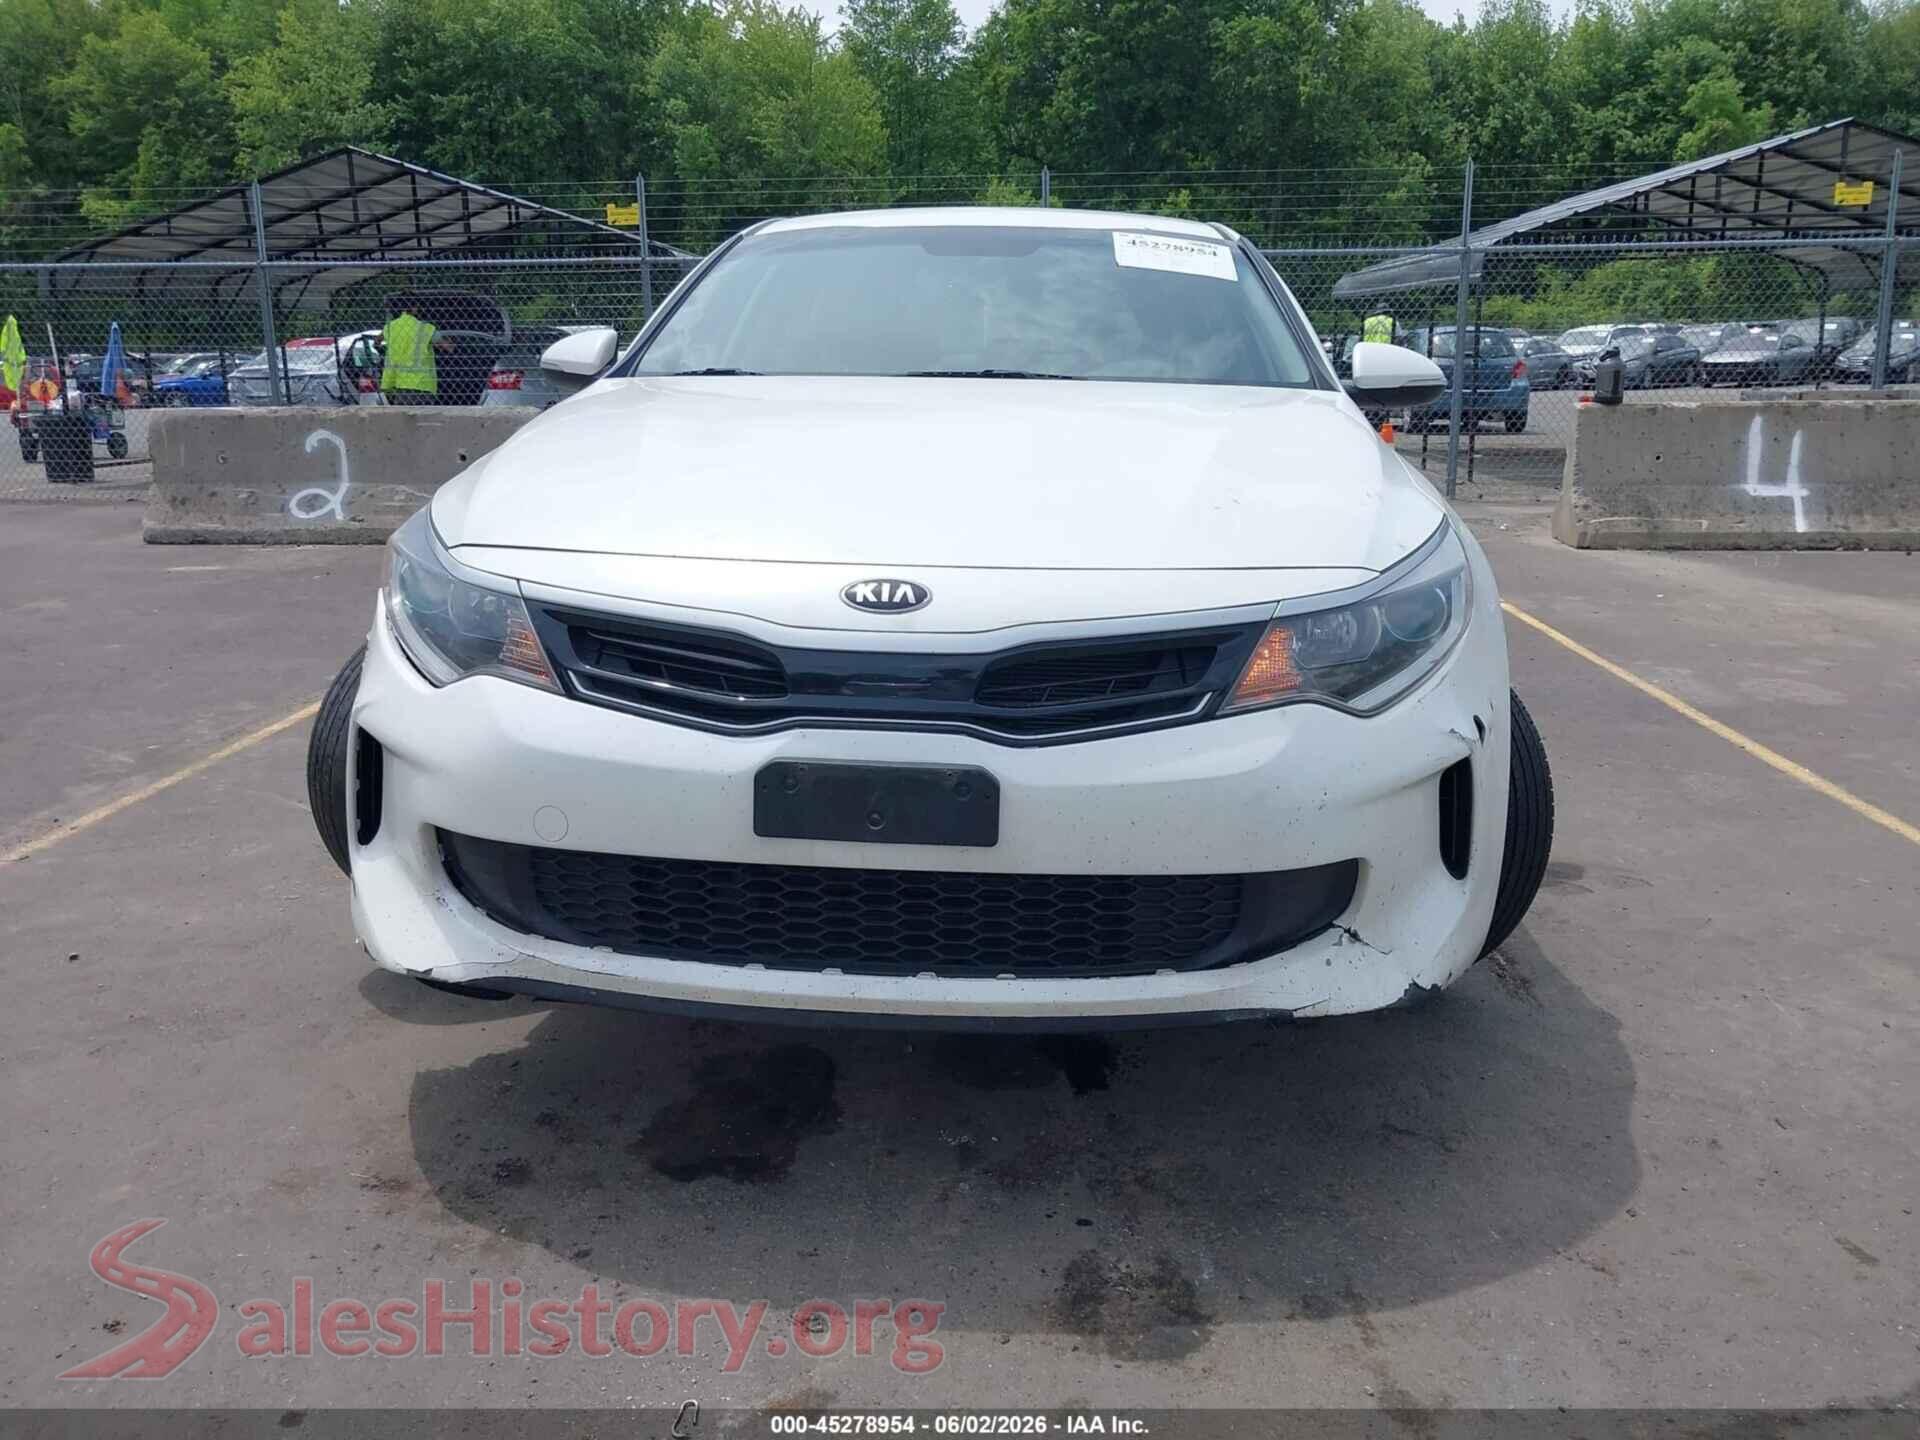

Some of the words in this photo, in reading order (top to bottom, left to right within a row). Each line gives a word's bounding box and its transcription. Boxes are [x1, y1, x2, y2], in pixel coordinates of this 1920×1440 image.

[289, 430, 349, 519] 2
[1741, 415, 1811, 532] 4
[849, 582, 917, 604] KIA
